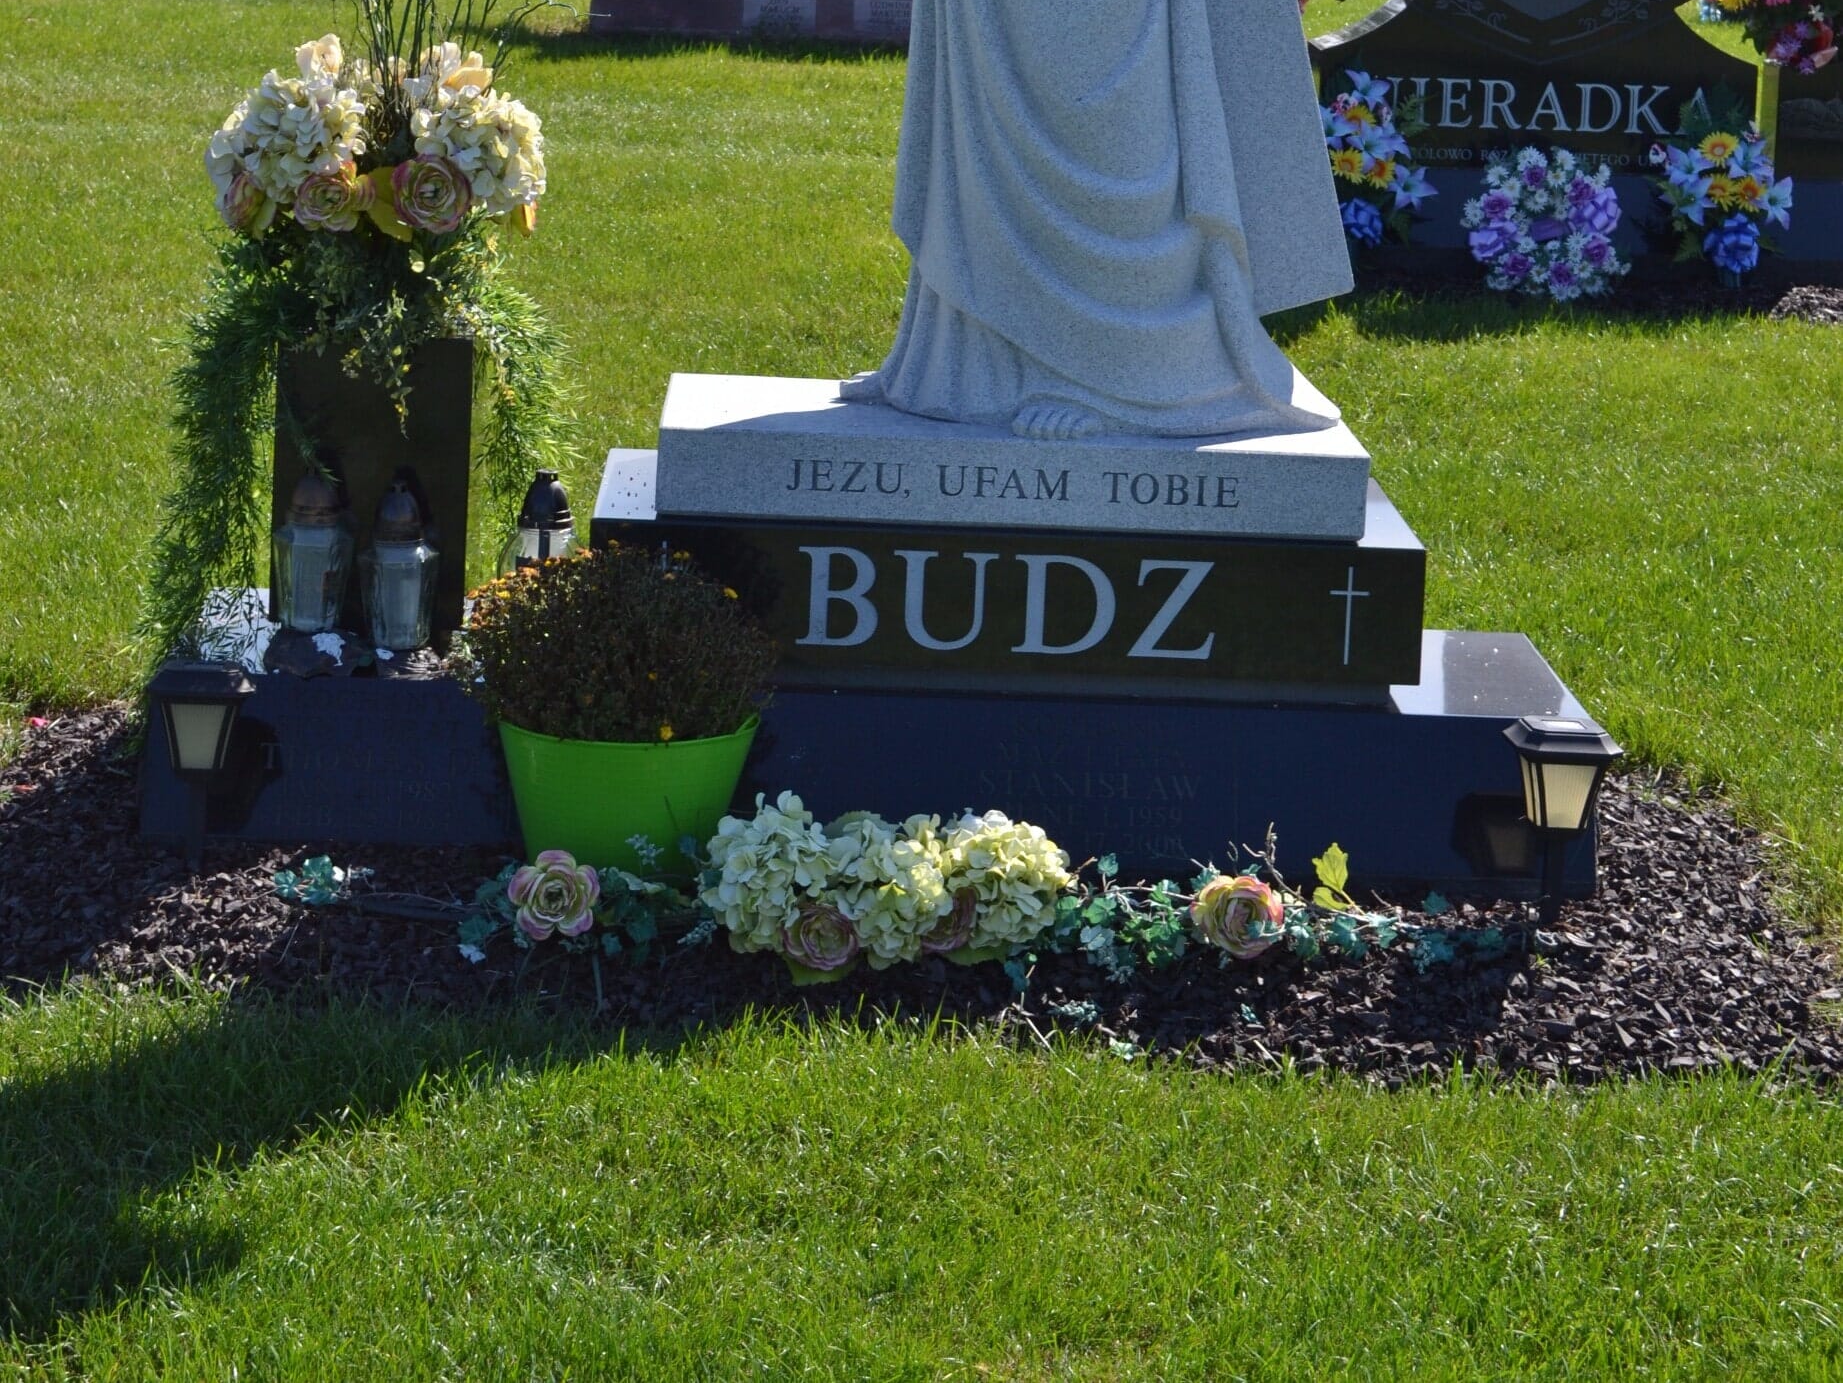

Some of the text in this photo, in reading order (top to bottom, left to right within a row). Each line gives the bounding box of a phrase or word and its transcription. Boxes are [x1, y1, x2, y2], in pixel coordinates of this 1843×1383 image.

[786, 457, 1242, 509] JEZU, UFAM TOBIE
[795, 545, 1216, 660] BUDZ
